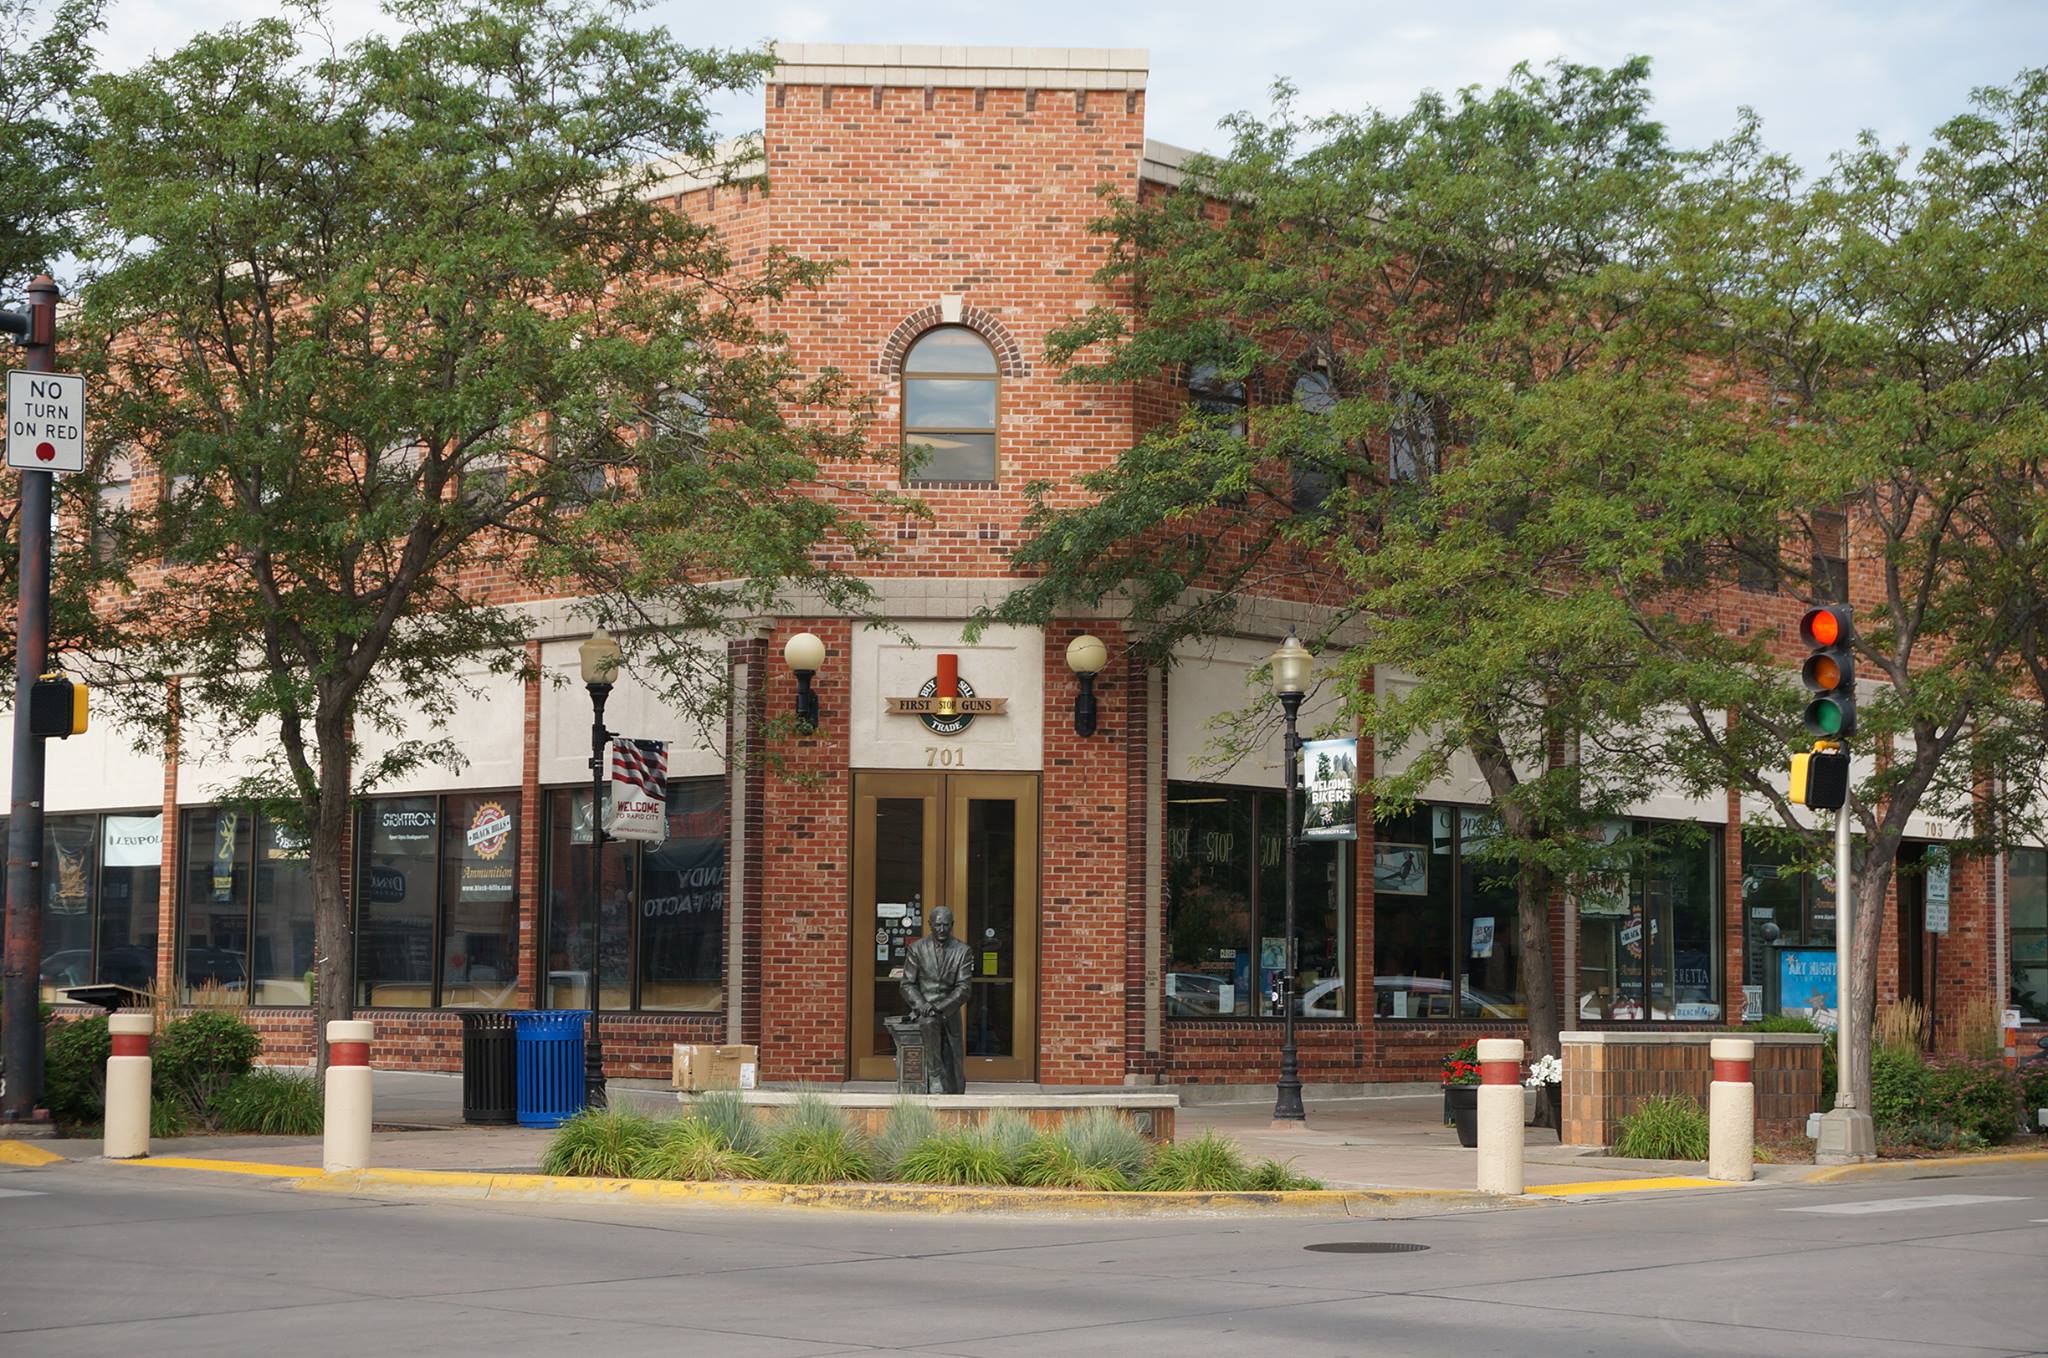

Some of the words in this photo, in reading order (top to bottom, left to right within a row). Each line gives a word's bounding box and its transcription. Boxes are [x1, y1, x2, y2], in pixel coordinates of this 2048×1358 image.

[31, 380, 62, 399] NO
[25, 403, 68, 420] TURN
[14, 421, 36, 437] ON
[46, 425, 78, 440] RED
[920, 679, 936, 698] BUY
[958, 680, 973, 698] SELL
[899, 700, 932, 711] FIRST
[939, 700, 956, 710] STOP
[961, 700, 992, 711] GUNS
[931, 720, 962, 732] TRADE
[924, 746, 965, 767] 701
[1311, 778, 1352, 791] WELCOME
[1311, 790, 1351, 804] BIKERS
[617, 801, 660, 814] WELCOME
[382, 812, 436, 827] SIGHTRON
[615, 812, 625, 820] TO
[627, 812, 645, 820] RAPID
[472, 828, 491, 841] BLACK
[491, 820, 507, 834] HILLS
[1925, 821, 1943, 837] 703
[1206, 832, 1234, 862] STOP
[462, 866, 513, 879] Ammunition
[1623, 928, 1640, 940] BLACK
[1788, 959, 1806, 976] ART
[1808, 961, 1837, 976] NIGHT
